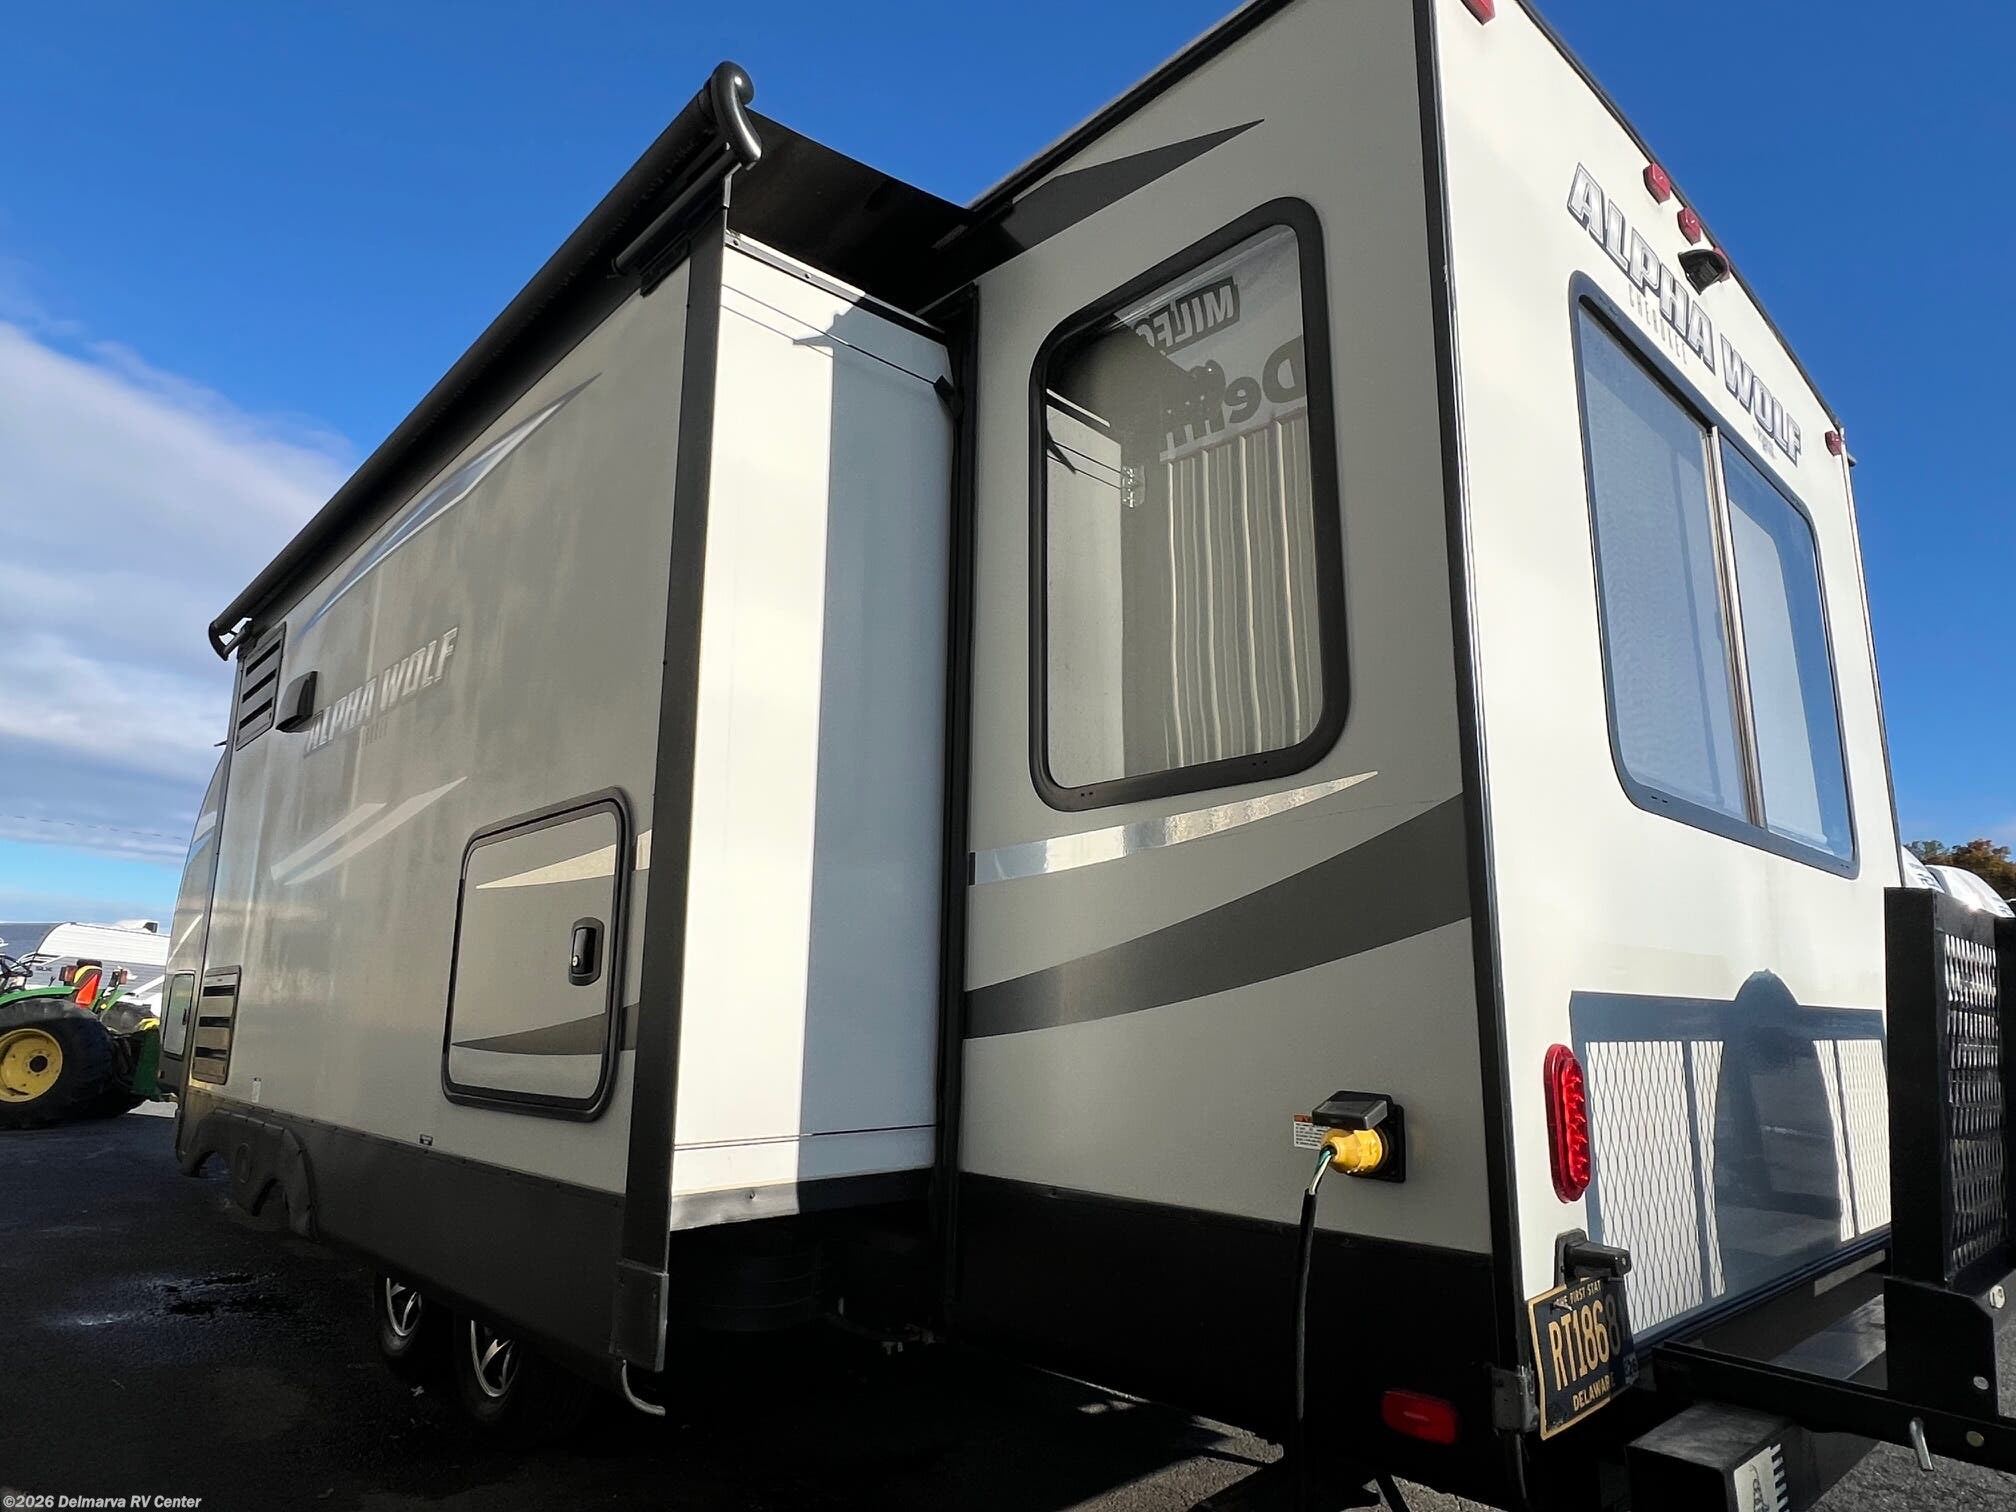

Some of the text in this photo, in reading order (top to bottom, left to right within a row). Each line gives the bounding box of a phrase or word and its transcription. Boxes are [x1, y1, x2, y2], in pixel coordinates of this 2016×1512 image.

[1567, 162, 1802, 467] ALPHA WOLF
[303, 626, 459, 759] ALPHA WOLF
[1548, 1293, 1621, 1392] RT1868
[1572, 1371, 1616, 1412] DELAWARE
